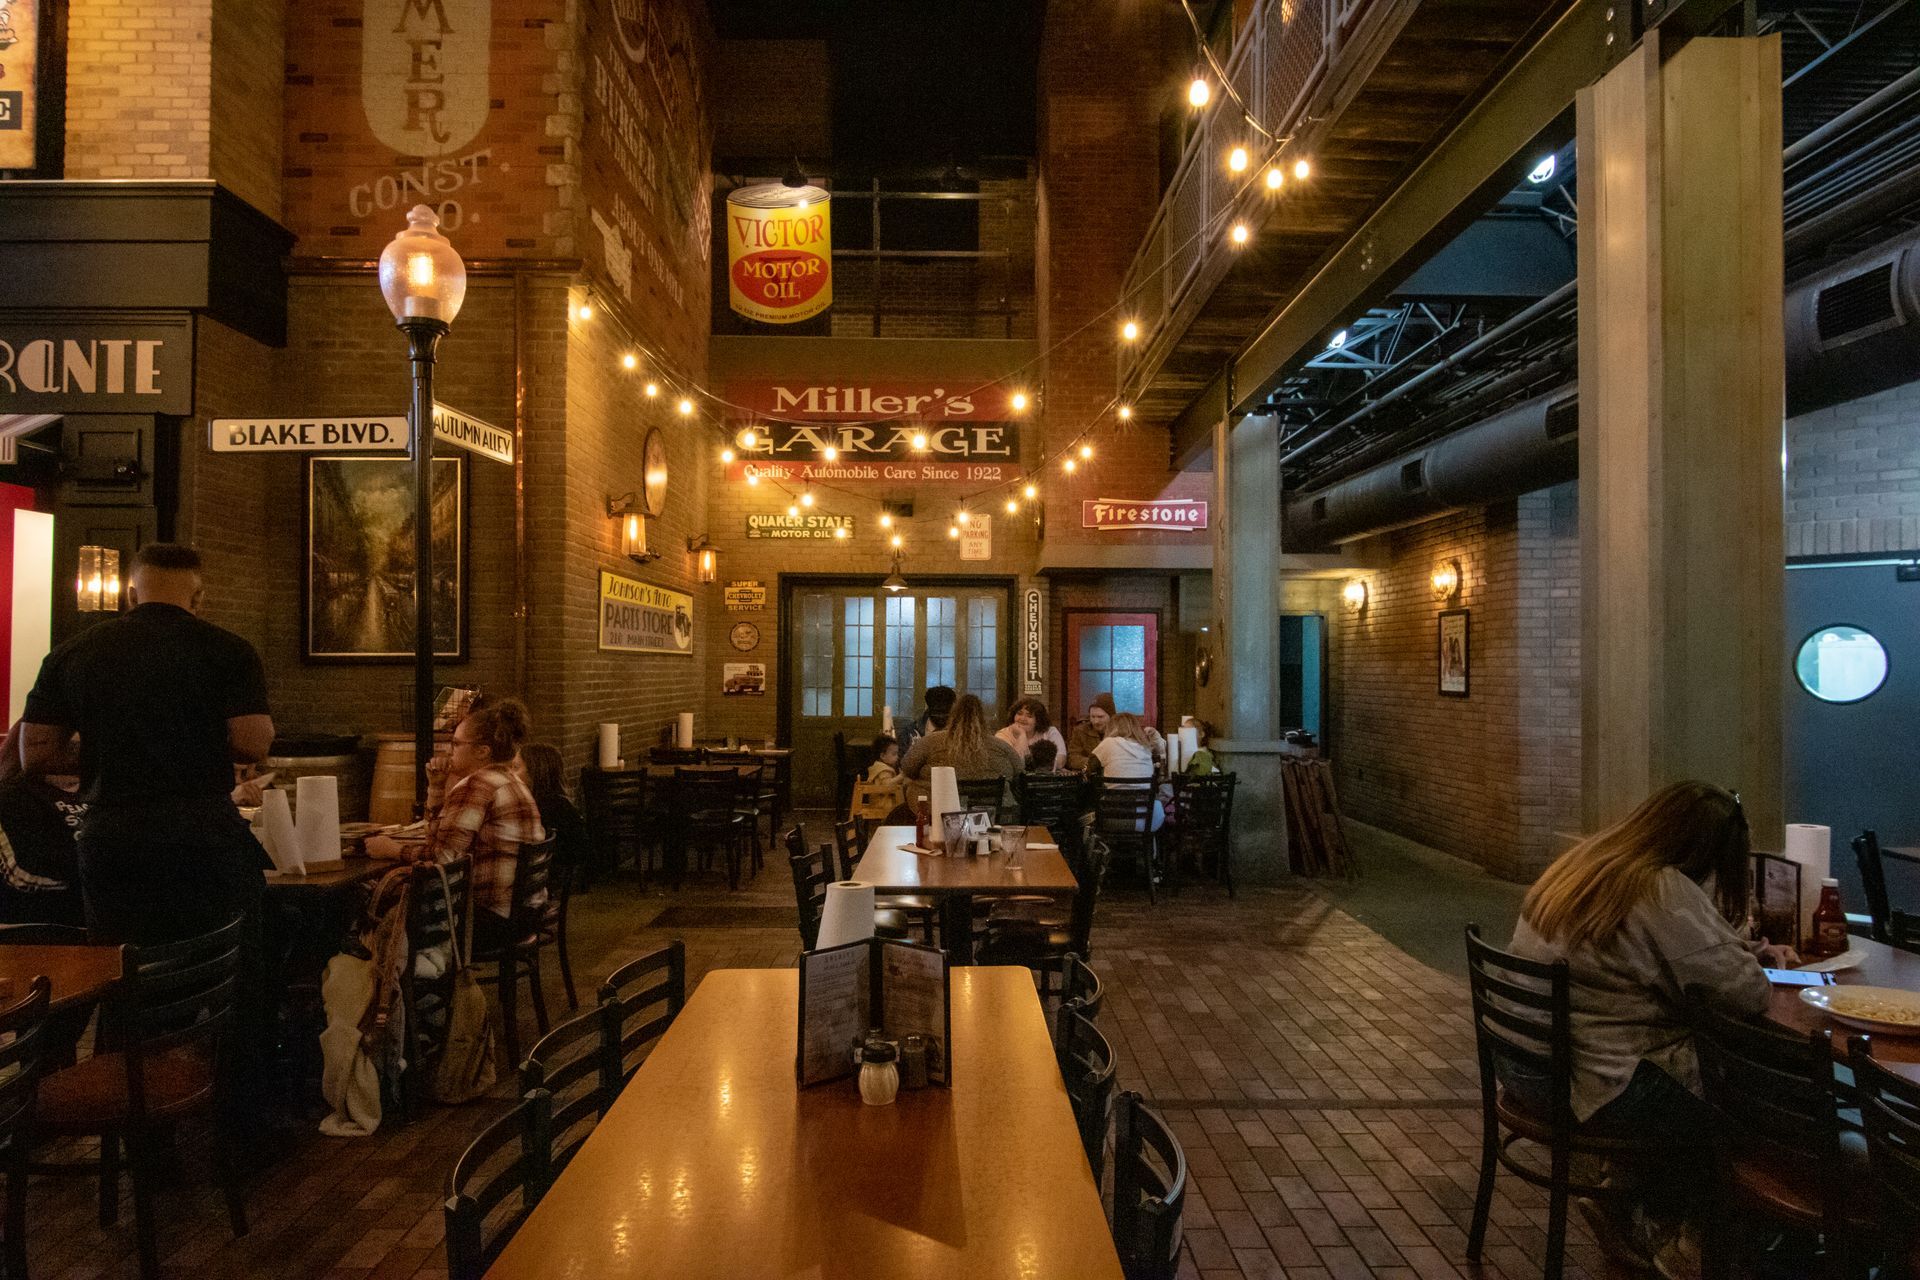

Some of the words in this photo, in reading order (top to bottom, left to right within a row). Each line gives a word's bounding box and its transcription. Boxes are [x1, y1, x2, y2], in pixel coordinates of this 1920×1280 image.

[733, 214, 824, 248] VICTOR
[743, 258, 821, 279] MOTOR
[763, 281, 801, 298] OIL
[772, 386, 975, 417] Miller's
[229, 423, 315, 446] BLAKE
[323, 422, 394, 445] BLVD.
[433, 412, 481, 446] AUTUMN
[482, 430, 511, 455] ALLEY
[736, 426, 1010, 456] GARAGE
[743, 465, 795, 480] Quality
[800, 464, 879, 479] Automobile
[884, 466, 917, 480] Care
[921, 465, 959, 480] Since
[966, 466, 1002, 481] 1922
[748, 515, 804, 529] QUAKER
[807, 516, 853, 529] STATE
[1092, 504, 1200, 524] Firestone
[771, 530, 813, 538] MOTOR
[814, 530, 831, 538] OIL
[962, 530, 989, 539] PARKING
[969, 520, 982, 529] NO
[654, 589, 671, 607] AUTO
[605, 603, 640, 631] PARTS
[642, 610, 674, 635] STORE
[1028, 593, 1039, 680] CHEVROLET
